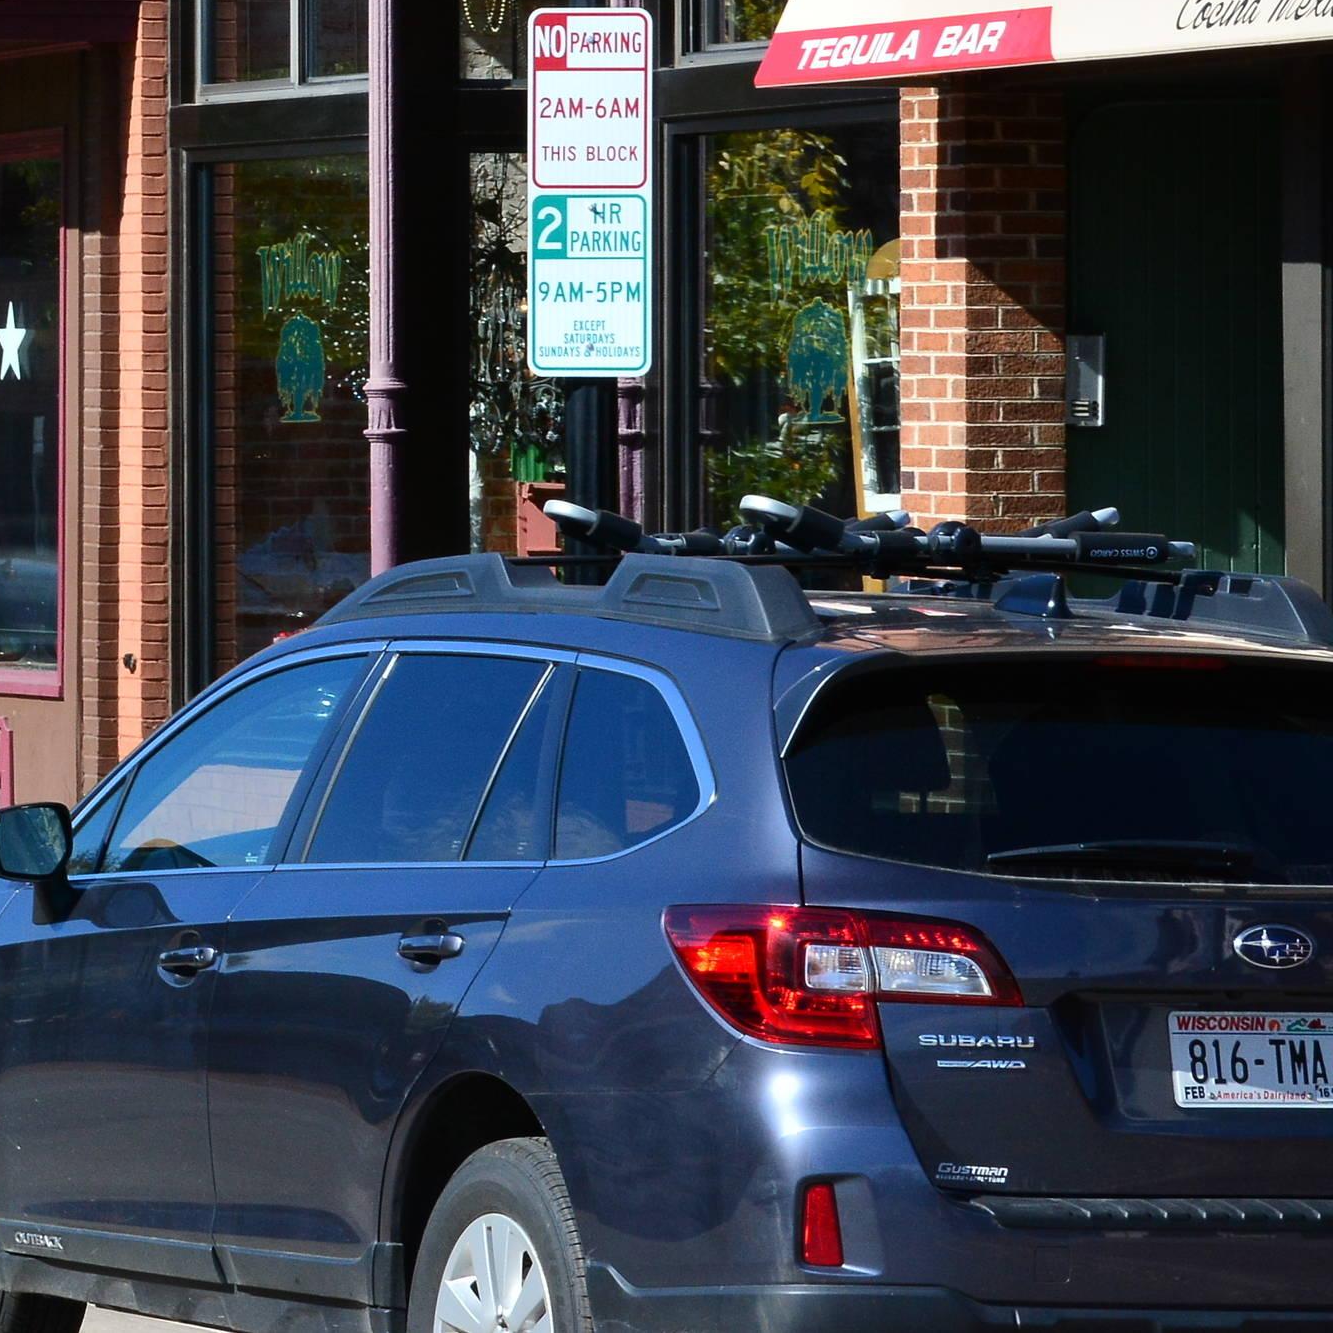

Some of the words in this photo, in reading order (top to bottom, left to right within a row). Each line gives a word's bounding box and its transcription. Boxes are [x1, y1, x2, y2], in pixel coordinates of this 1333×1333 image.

[535, 25, 567, 59] NO
[570, 32, 642, 53] PARKING
[797, 30, 920, 71] TEQUILA
[933, 20, 1006, 58] BAR
[539, 97, 640, 119] 2AM-6AM
[542, 145, 577, 162] THIS
[586, 145, 638, 162] BLOCK
[592, 203, 622, 224] HR
[537, 206, 563, 250] 2
[570, 231, 641, 252] PARKING
[762, 209, 874, 309] Willow
[256, 232, 342, 322] Willow
[538, 281, 641, 303] 9AM-5PM
[573, 320, 606, 331] EXCEPT
[563, 333, 616, 344] SATURDAYS
[538, 346, 581, 357] SUNDAYS
[595, 346, 641, 357] HOLIDAYS
[1176, 1016, 1267, 1032] WISCONSIN
[918, 1034, 1035, 1048] SUBARU
[969, 1059, 1027, 1069] AWD
[1188, 1038, 1330, 1085] 816-TMA
[1184, 1086, 1206, 1100] FEB
[1217, 1089, 1262, 1101] America's
[1263, 1089, 1308, 1103] Dairyland
[14, 1231, 64, 1250] OUTBACK
